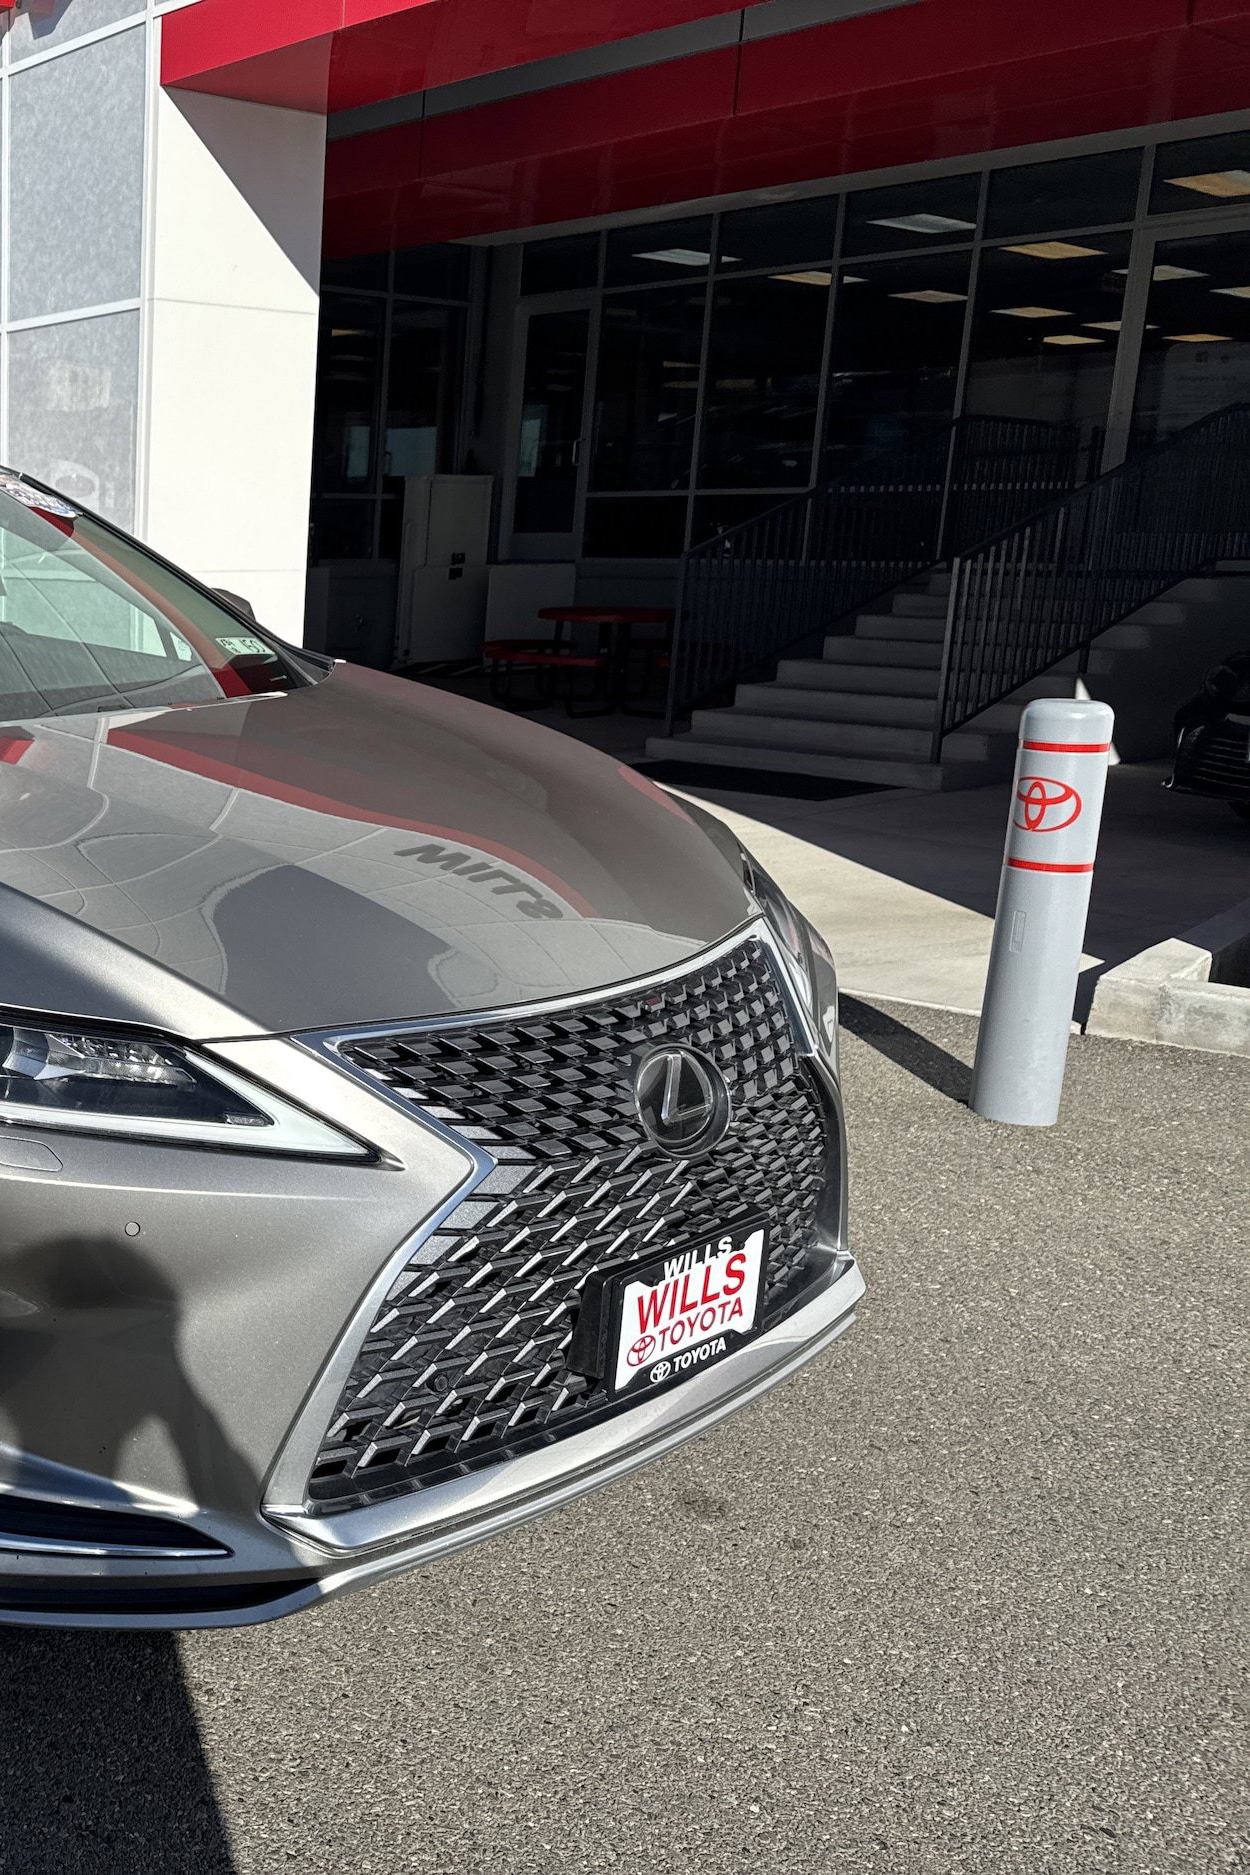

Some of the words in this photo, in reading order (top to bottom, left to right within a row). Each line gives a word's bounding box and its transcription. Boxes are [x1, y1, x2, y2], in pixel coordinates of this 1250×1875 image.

[663, 1235, 733, 1281] WILLS
[636, 1252, 747, 1335] WILLS
[658, 1296, 744, 1352] TOYOTA
[672, 1336, 727, 1373] TOYOTA
